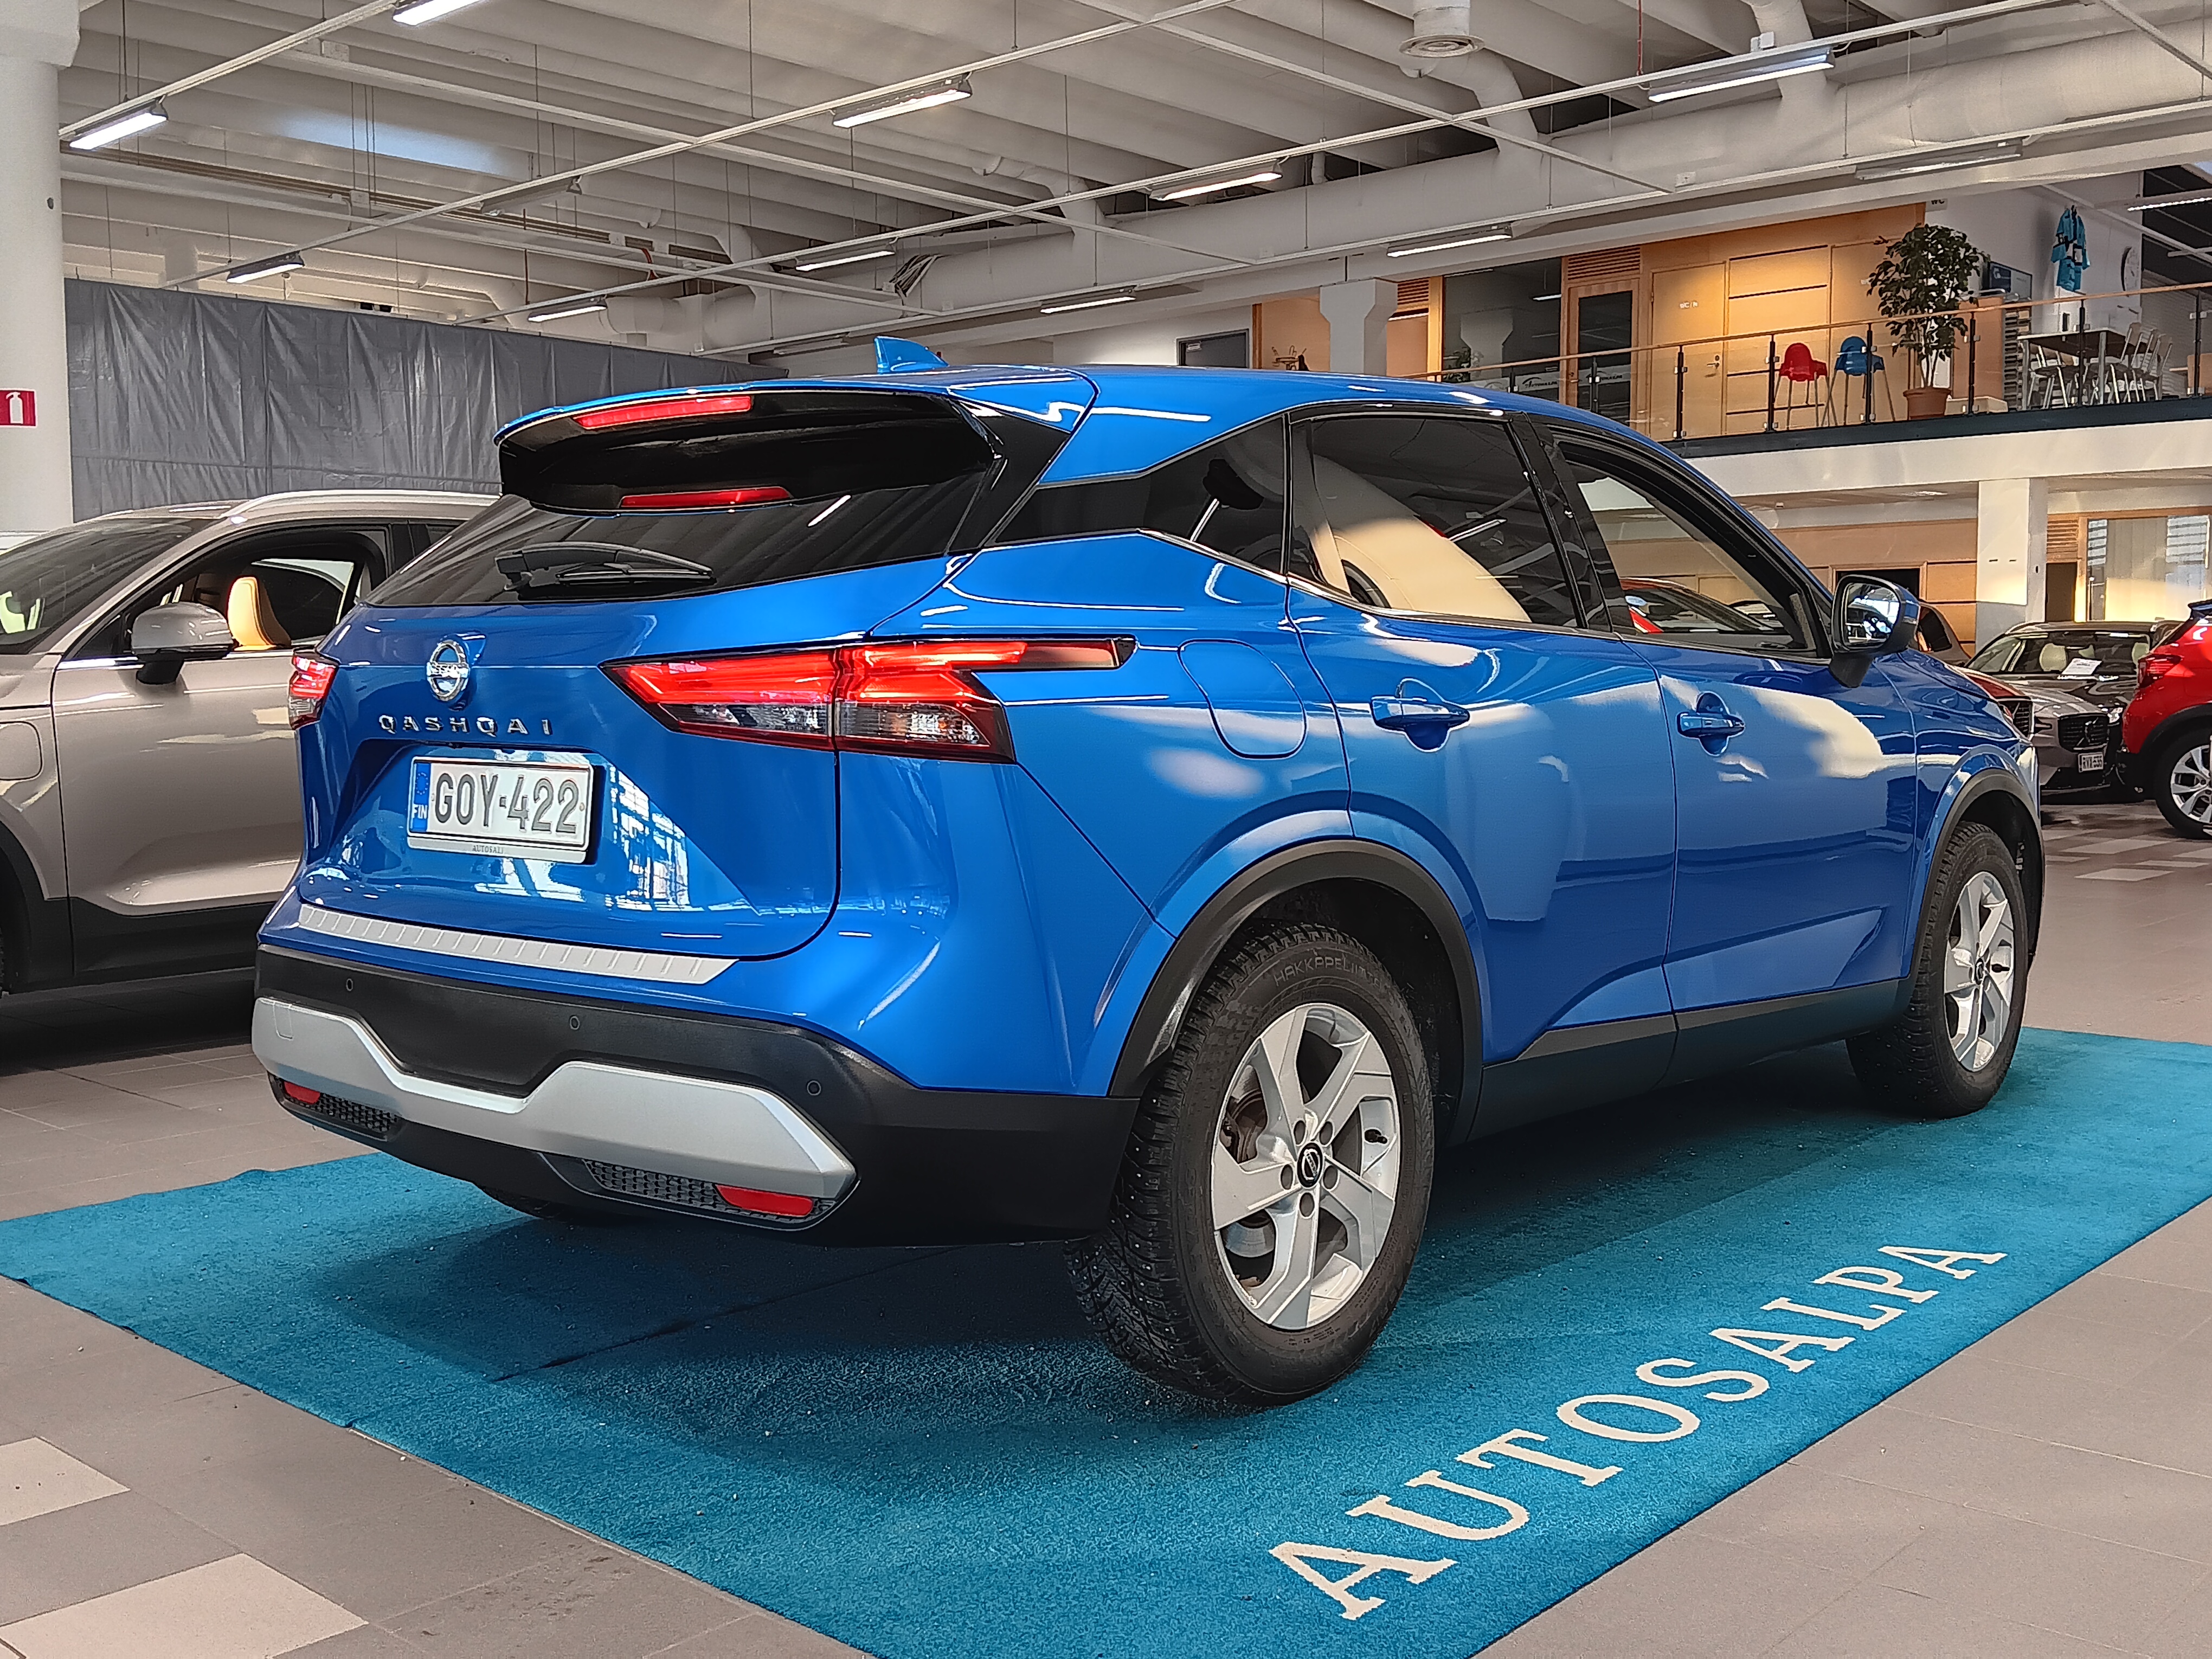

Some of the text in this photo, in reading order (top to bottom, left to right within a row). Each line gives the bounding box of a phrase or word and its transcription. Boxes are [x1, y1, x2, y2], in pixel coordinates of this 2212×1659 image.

[379, 715, 553, 737] QASHQAI
[412, 804, 428, 819] FIN
[435, 773, 579, 833] GOY-422
[1268, 1246, 2008, 1621] AUTOSALPA
